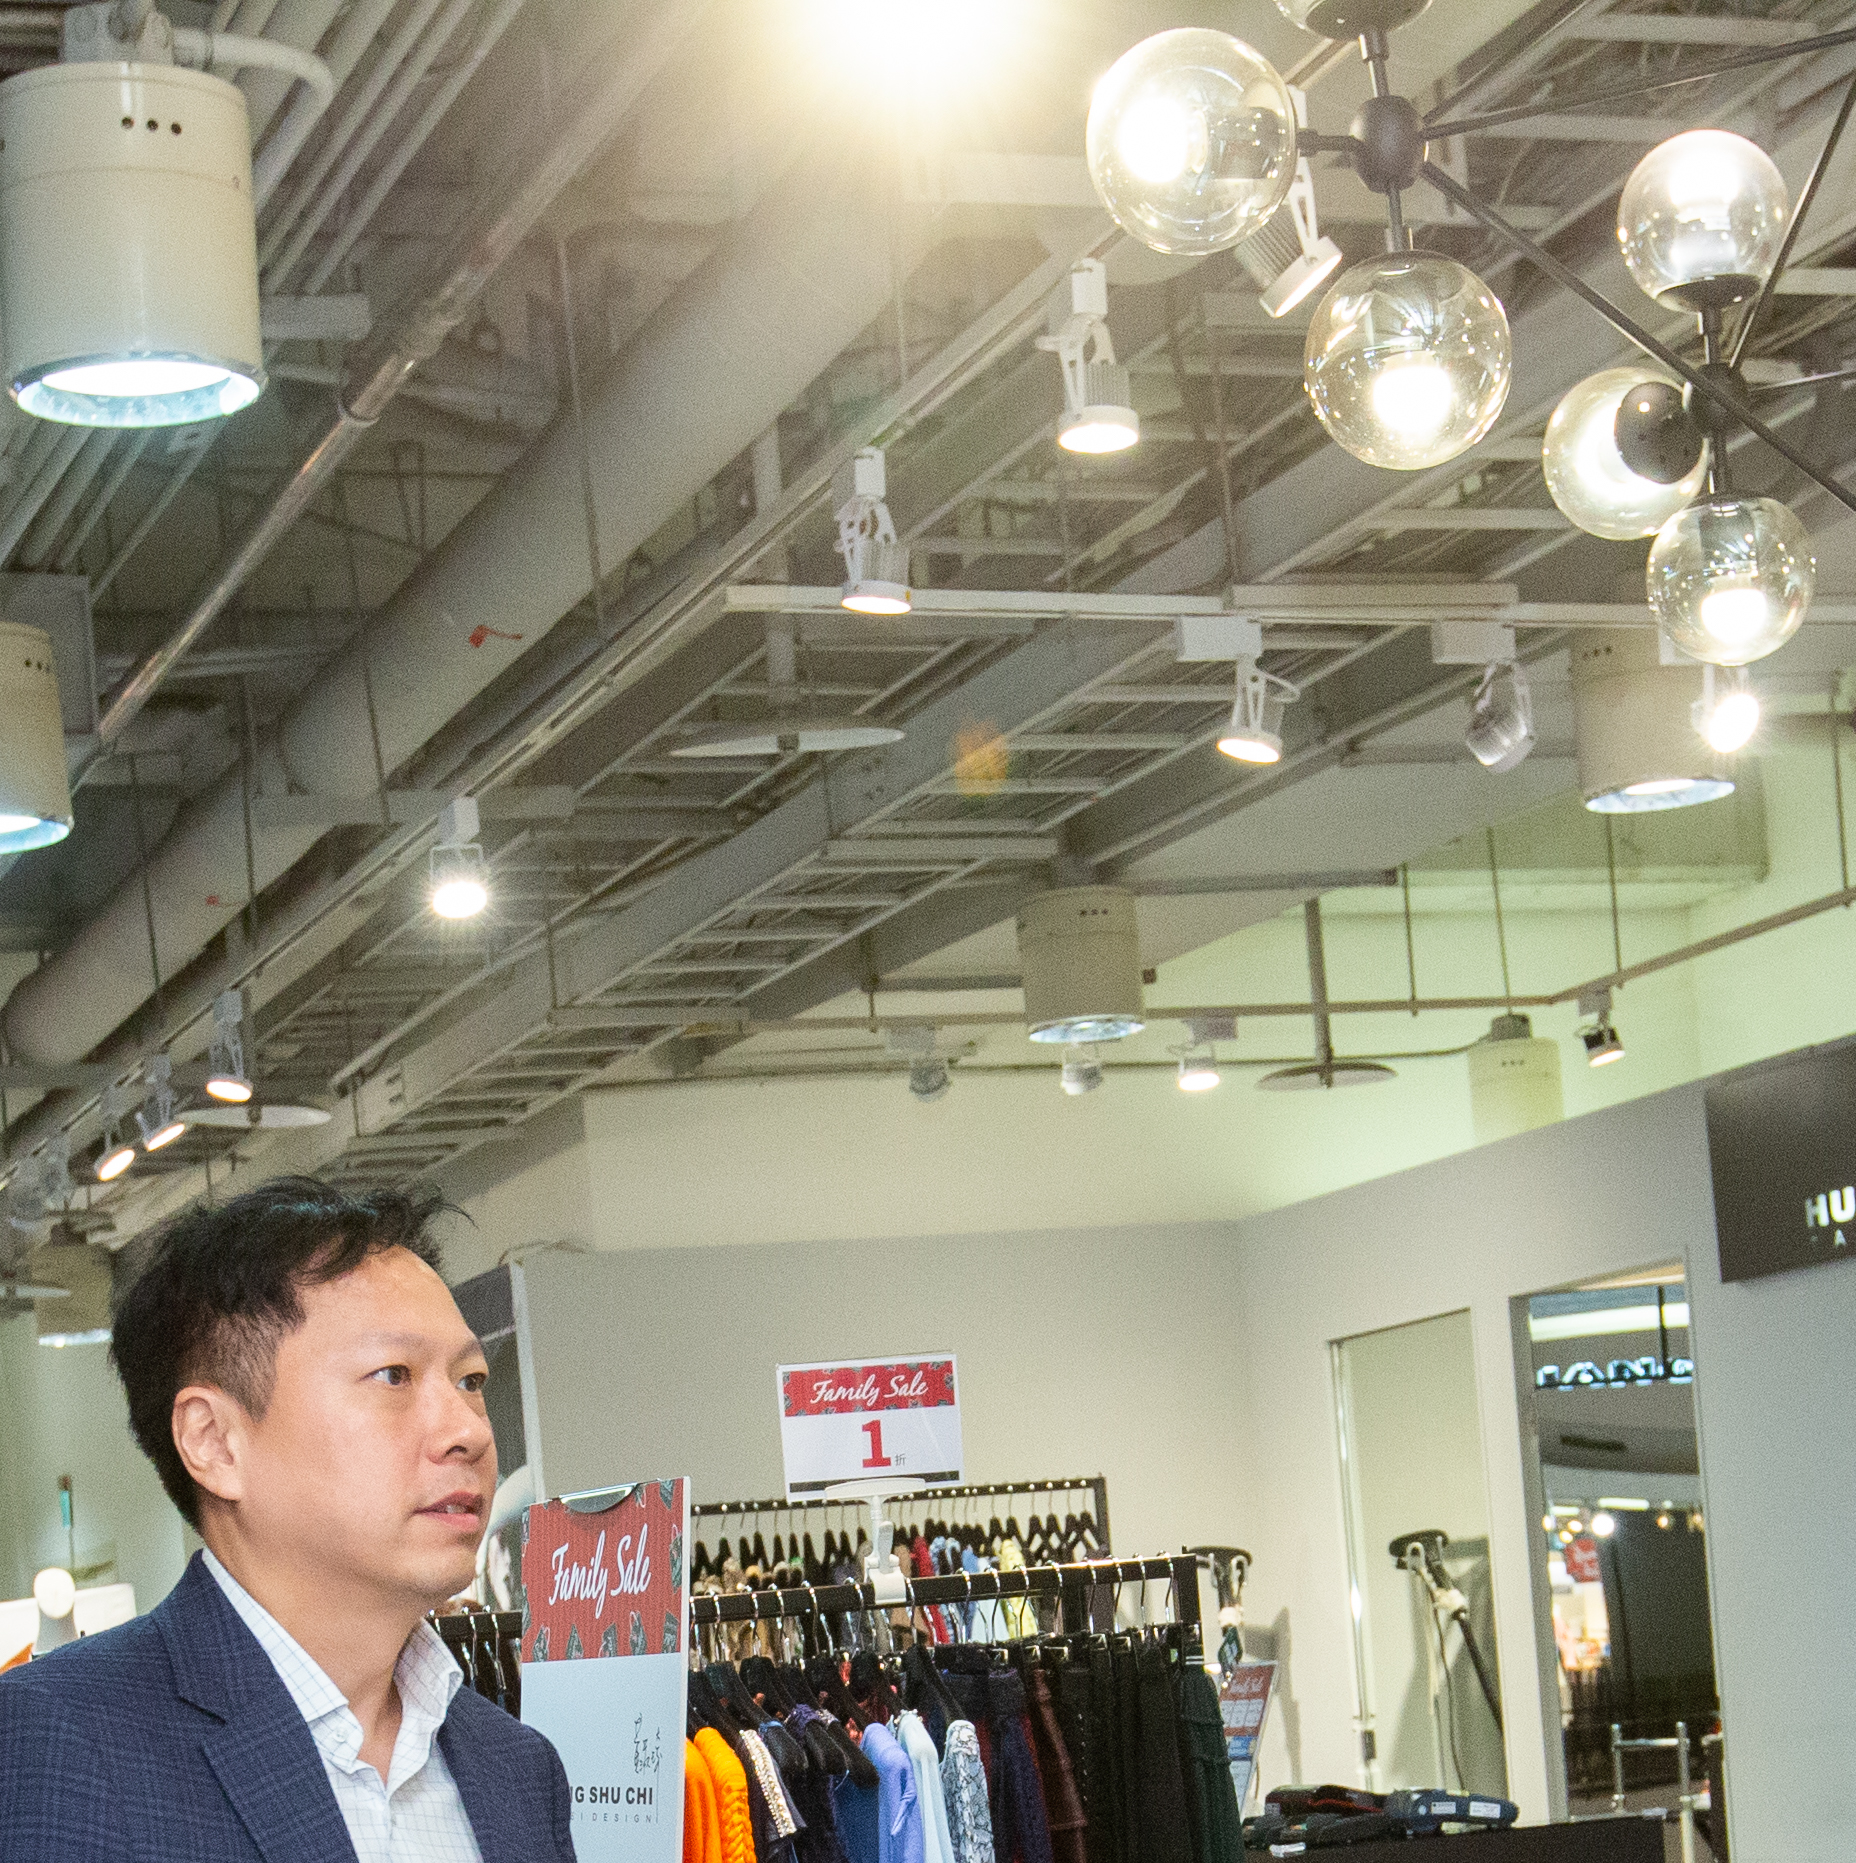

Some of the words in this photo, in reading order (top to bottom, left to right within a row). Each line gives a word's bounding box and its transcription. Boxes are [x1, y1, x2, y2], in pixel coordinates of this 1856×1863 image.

[809, 1373, 880, 1407] Family
[883, 1370, 929, 1398] Sale
[548, 1529, 609, 1620] Family
[610, 1522, 652, 1597] Sale
[589, 1785, 621, 1805] SHU
[625, 1786, 653, 1806] CHI
[592, 1812, 652, 1823] DESIGN
